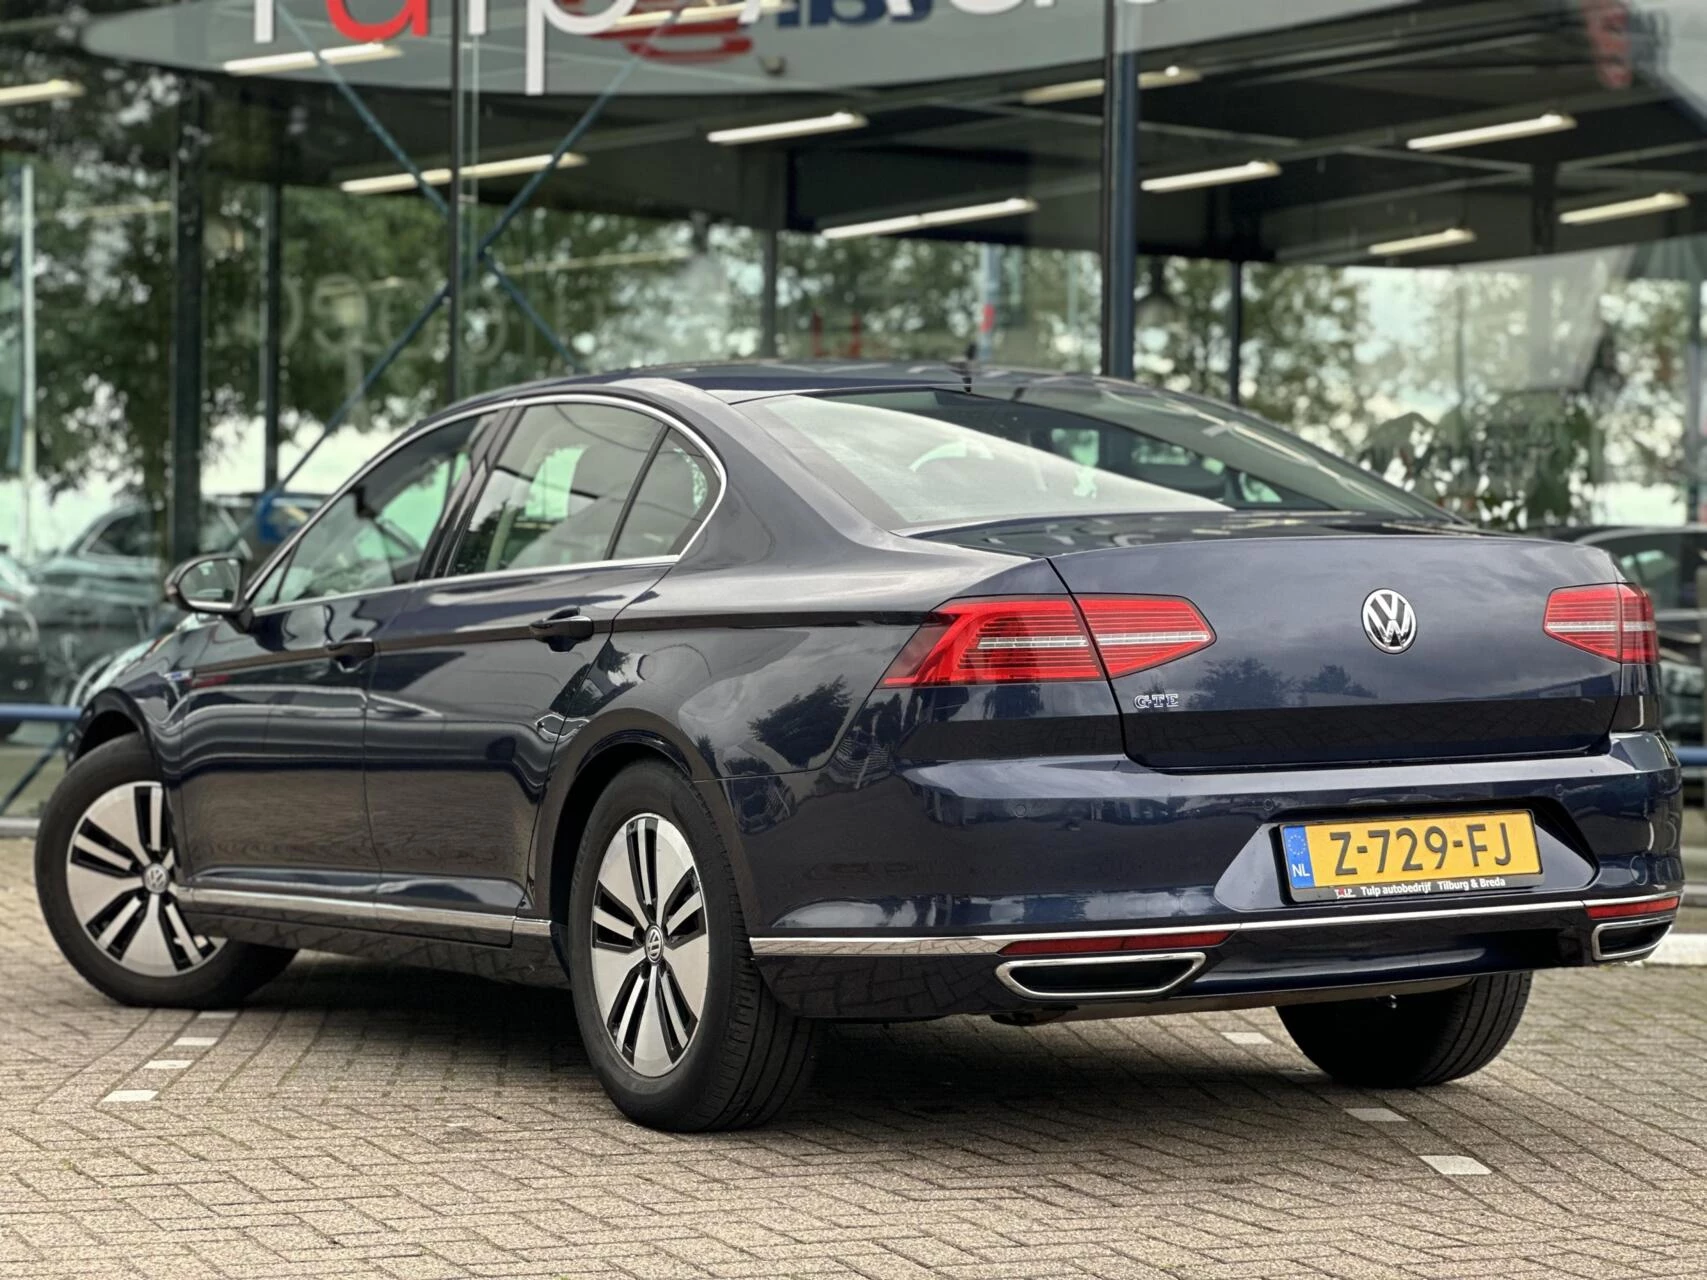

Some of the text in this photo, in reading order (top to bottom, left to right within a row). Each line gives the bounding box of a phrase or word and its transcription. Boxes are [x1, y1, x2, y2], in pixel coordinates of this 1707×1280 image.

[1134, 693, 1179, 709] GTE
[1329, 822, 1512, 877] Z-729-FJ
[1292, 863, 1311, 878] NL
[1360, 885, 1381, 897] Tulp
[1382, 881, 1431, 893] autobedrijf
[1437, 880, 1469, 891] Tilburg
[1470, 878, 1479, 888] &
[1479, 876, 1506, 888] Breda
